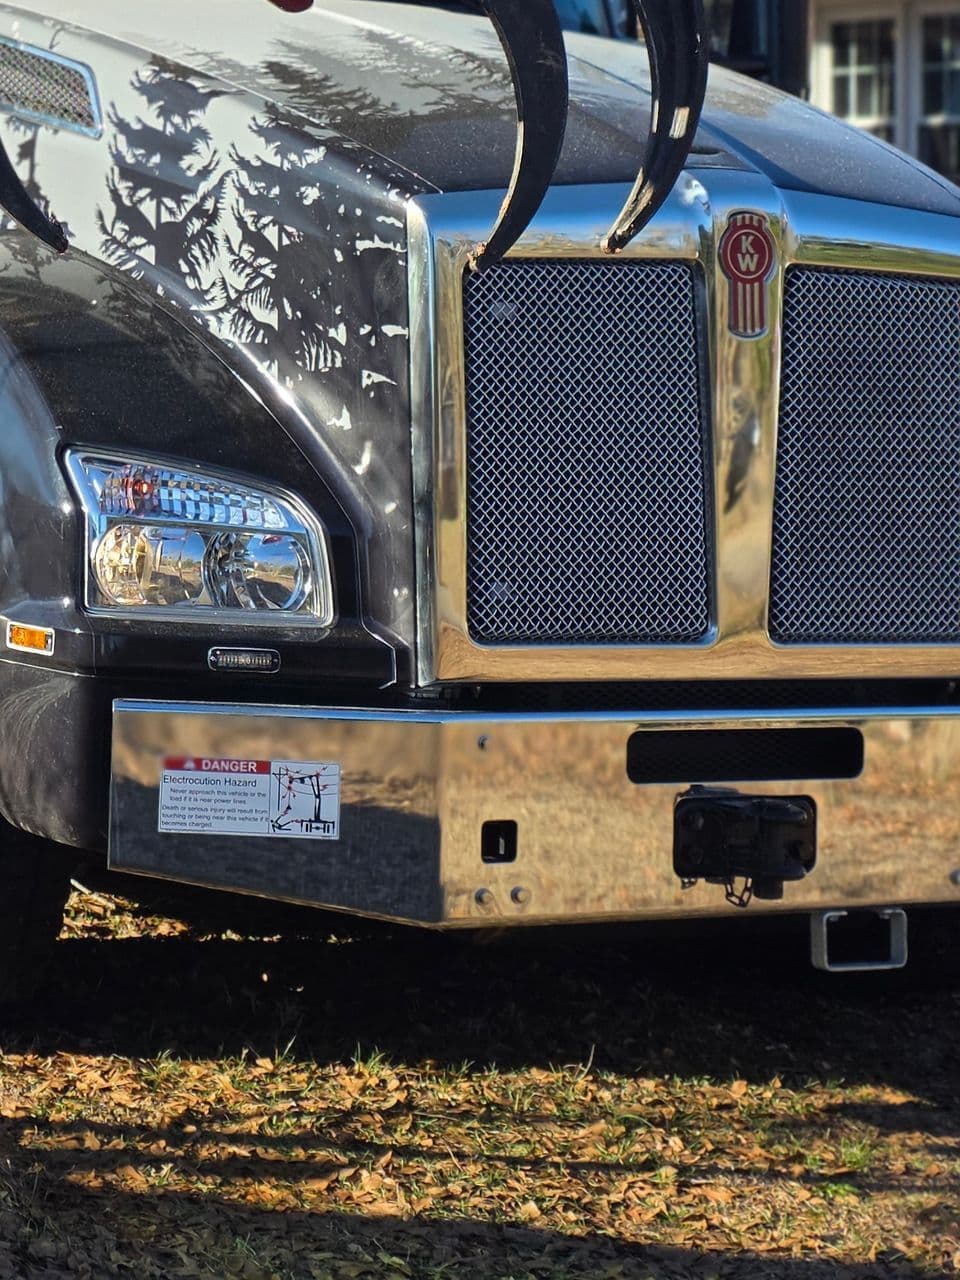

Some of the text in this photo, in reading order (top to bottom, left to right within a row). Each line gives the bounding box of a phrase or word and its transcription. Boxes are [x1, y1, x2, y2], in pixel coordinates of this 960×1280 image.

[202, 759, 257, 773] DANGER
[163, 775, 257, 787] Electrocution Hazard
